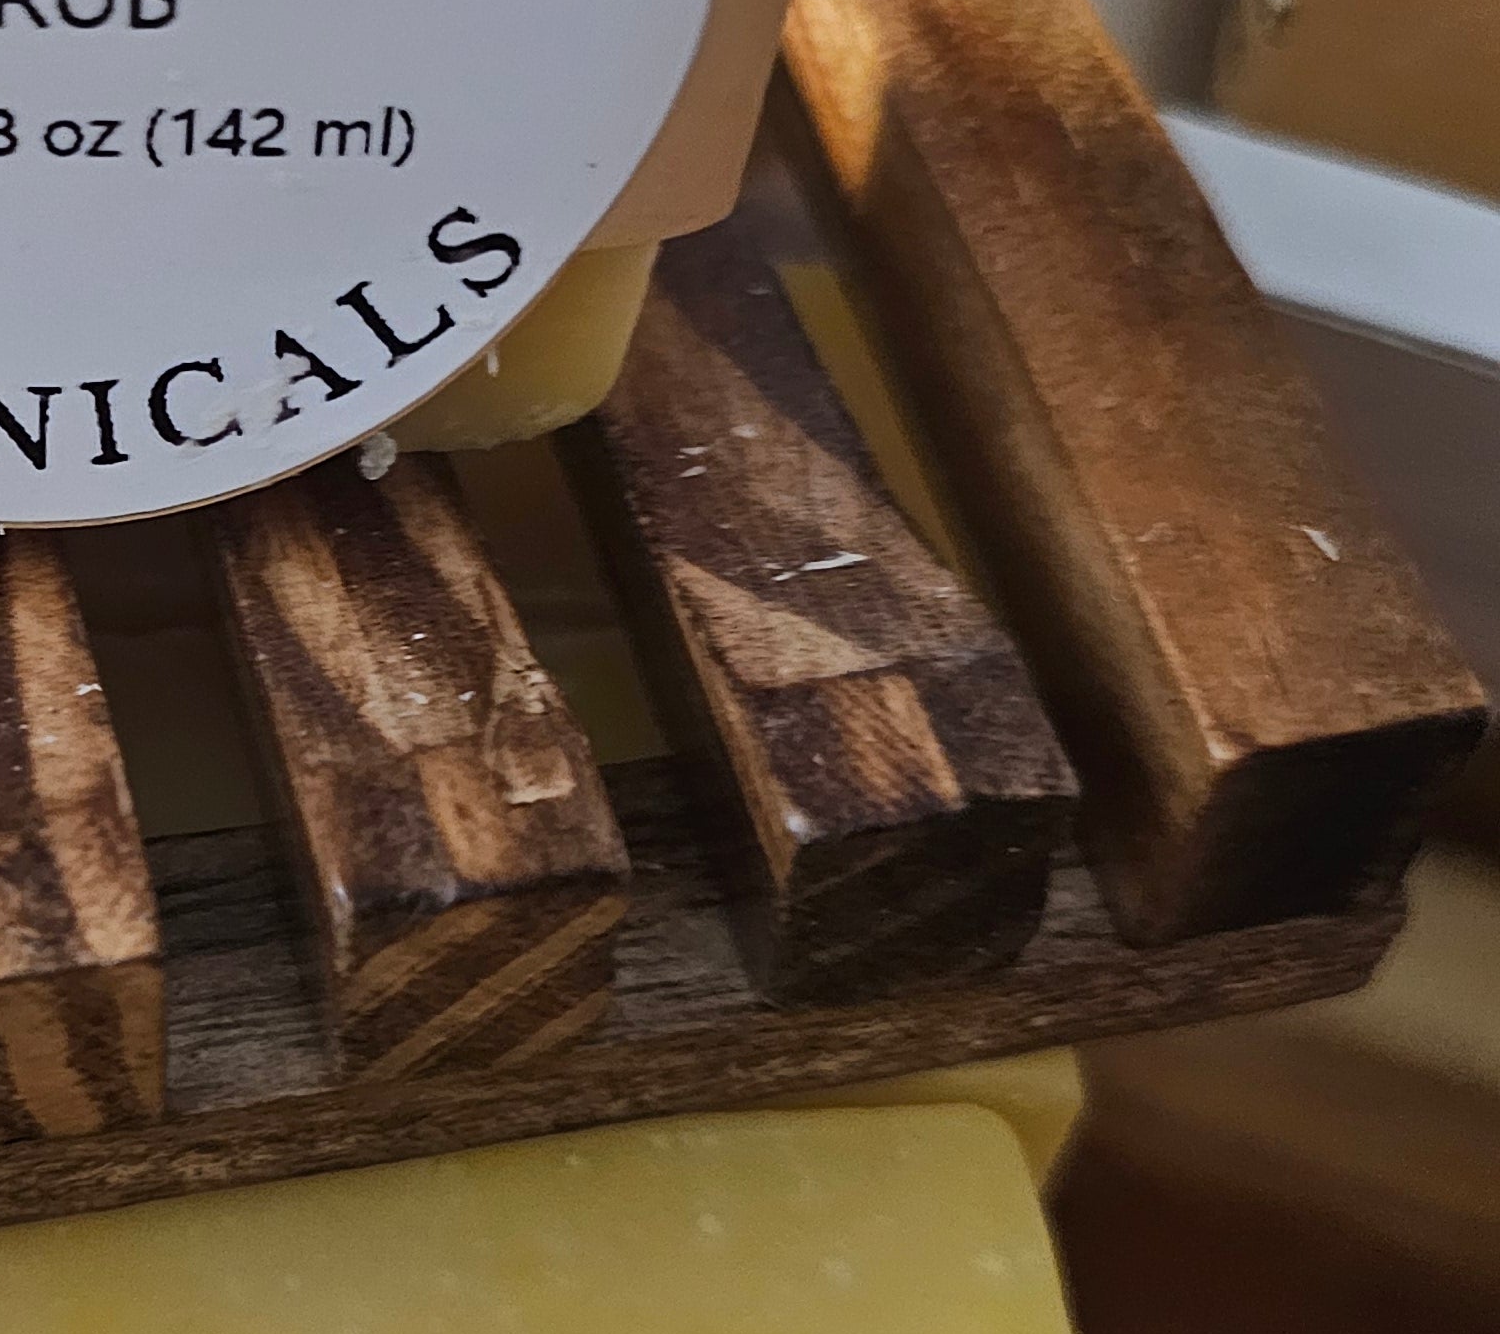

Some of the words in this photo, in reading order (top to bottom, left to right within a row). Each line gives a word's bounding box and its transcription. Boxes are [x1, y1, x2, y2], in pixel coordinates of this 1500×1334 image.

[41, 118, 124, 159] oz
[144, 106, 288, 168] (142
[312, 105, 417, 168] ml)
